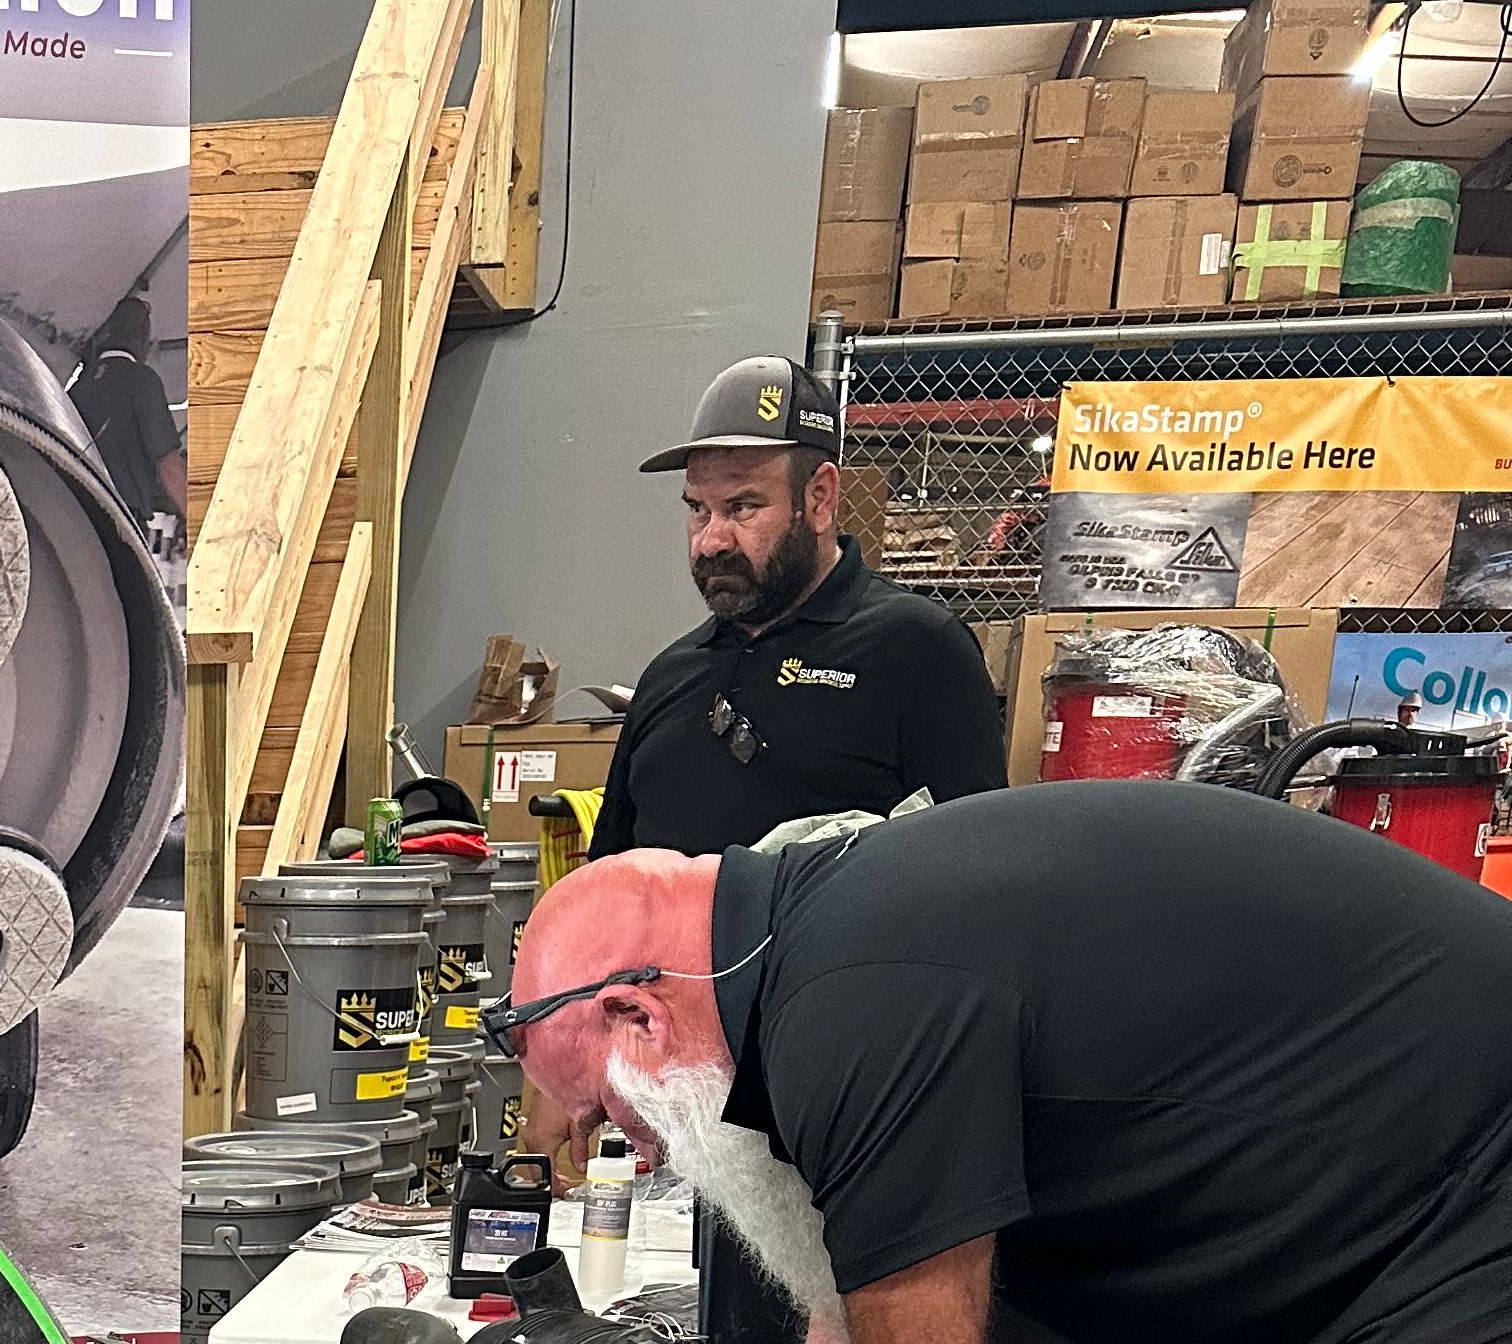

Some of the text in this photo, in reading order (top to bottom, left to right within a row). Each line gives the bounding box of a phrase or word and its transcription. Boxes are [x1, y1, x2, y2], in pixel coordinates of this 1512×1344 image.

[3, 29, 86, 59] Made
[1068, 440, 1376, 472] Now Available Here
[798, 668, 856, 684] SUPERIOR
[1383, 646, 1512, 720] Collo
